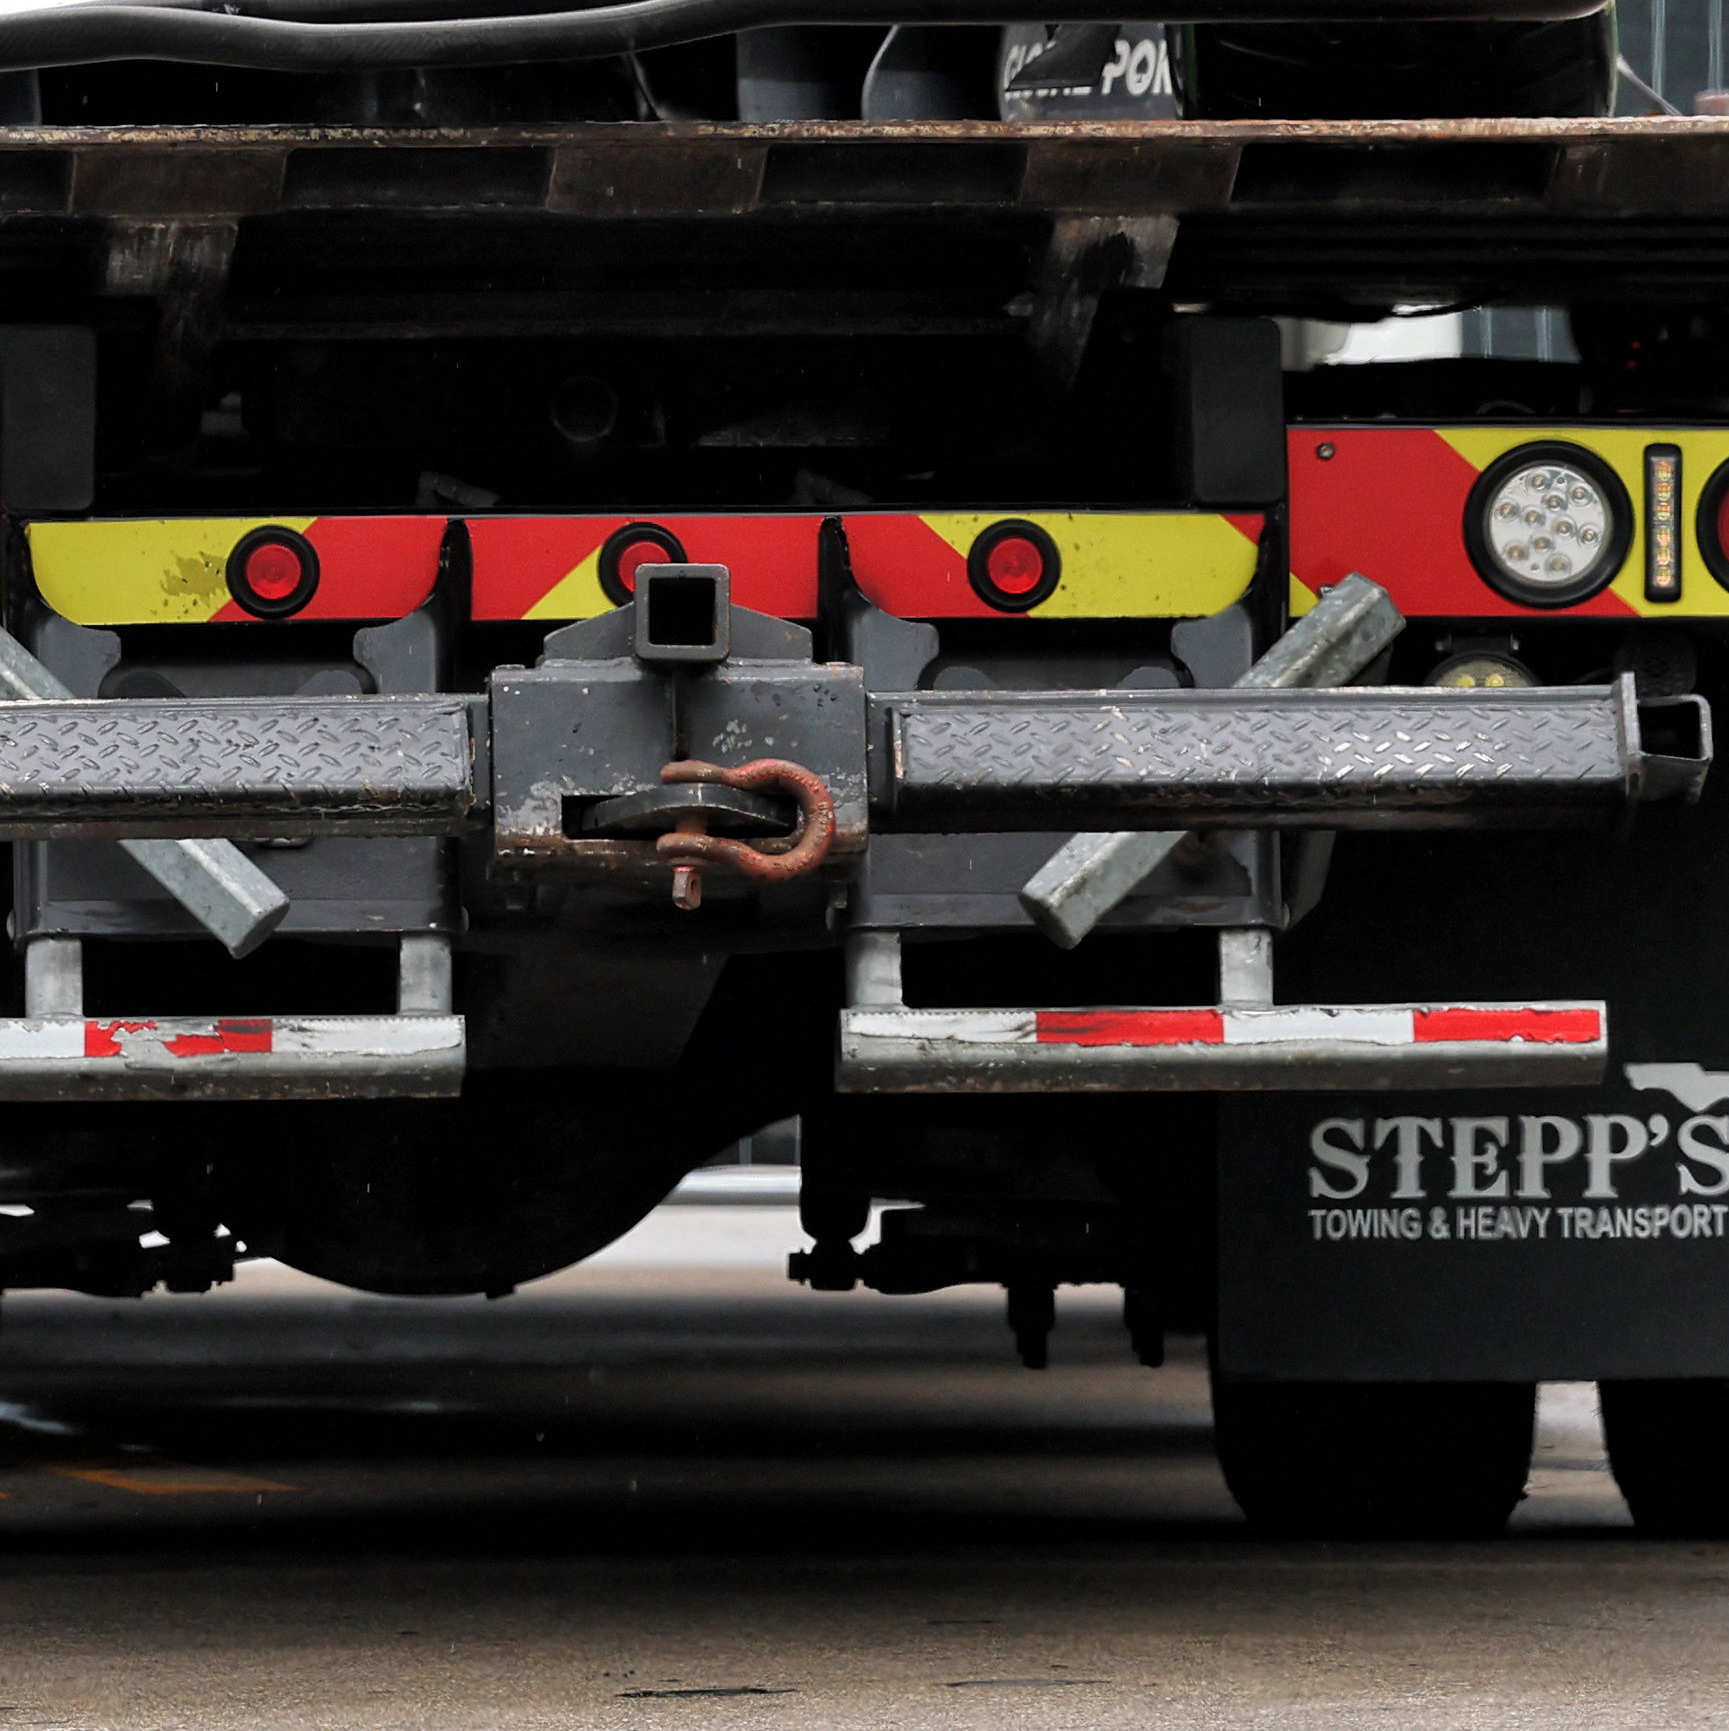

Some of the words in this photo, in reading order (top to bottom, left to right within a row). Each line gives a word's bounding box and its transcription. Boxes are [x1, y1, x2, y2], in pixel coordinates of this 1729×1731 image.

[1308, 1206, 1423, 1240] TOWING
[1429, 1206, 1452, 1239] &
[1457, 1205, 1552, 1239] HEAVY
[1556, 1203, 1729, 1239] TRANSPORT
